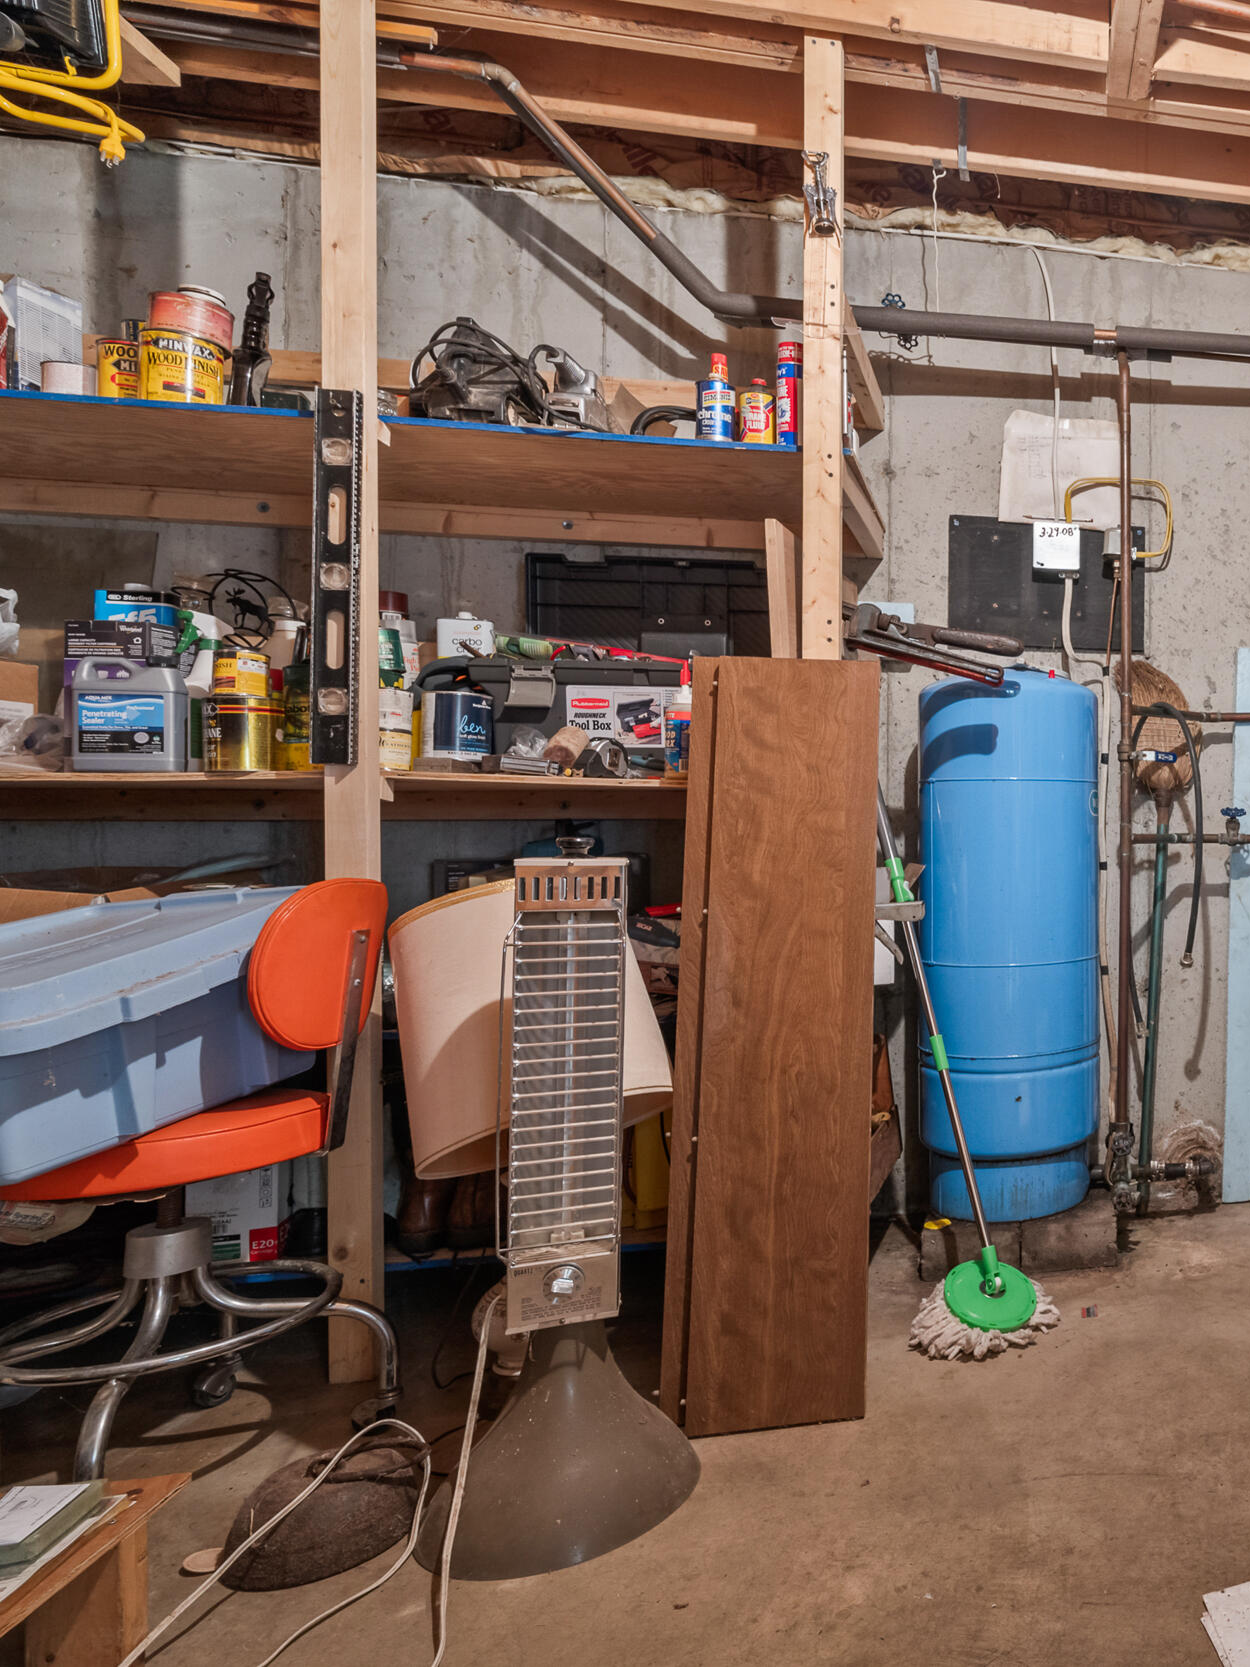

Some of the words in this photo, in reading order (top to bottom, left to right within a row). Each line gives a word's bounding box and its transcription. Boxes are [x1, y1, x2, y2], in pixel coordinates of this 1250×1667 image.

[159, 338, 210, 360] MINWAX
[147, 351, 183, 366] WOOD
[123, 594, 153, 602] Sterling
[82, 709, 128, 720] Penetrating
[569, 720, 590, 730] Tool
[592, 720, 612, 731] Box
